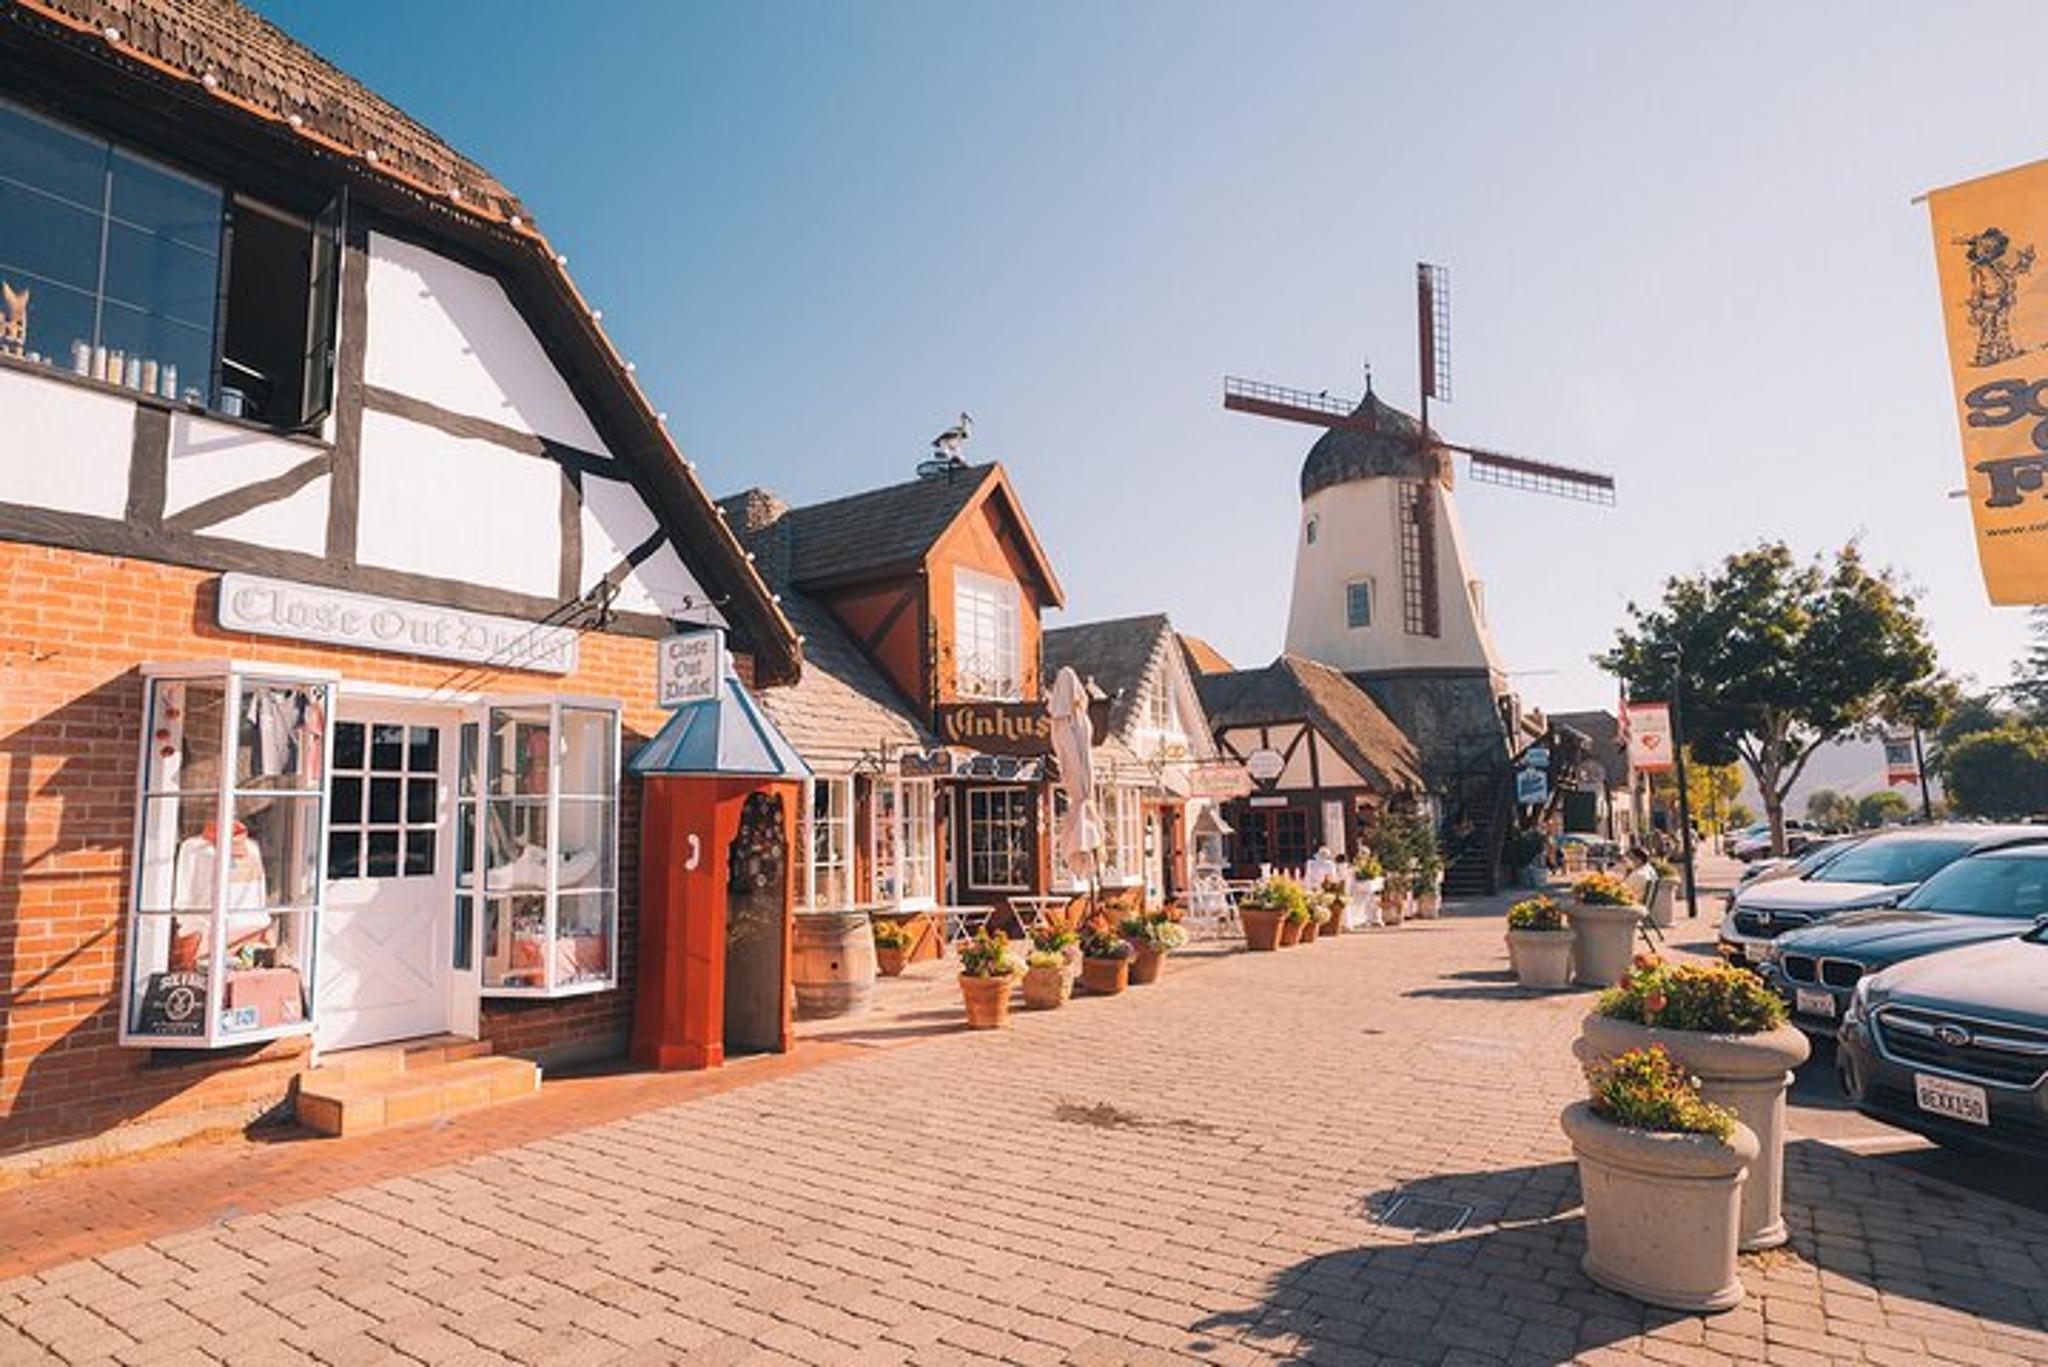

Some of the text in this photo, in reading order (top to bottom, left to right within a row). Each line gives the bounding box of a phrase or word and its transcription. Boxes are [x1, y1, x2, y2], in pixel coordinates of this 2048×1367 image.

[1974, 454, 2048, 507] F
[232, 586, 360, 636] Close
[369, 608, 451, 647] Out
[668, 640, 708, 660] Close
[674, 659, 702, 678] Out
